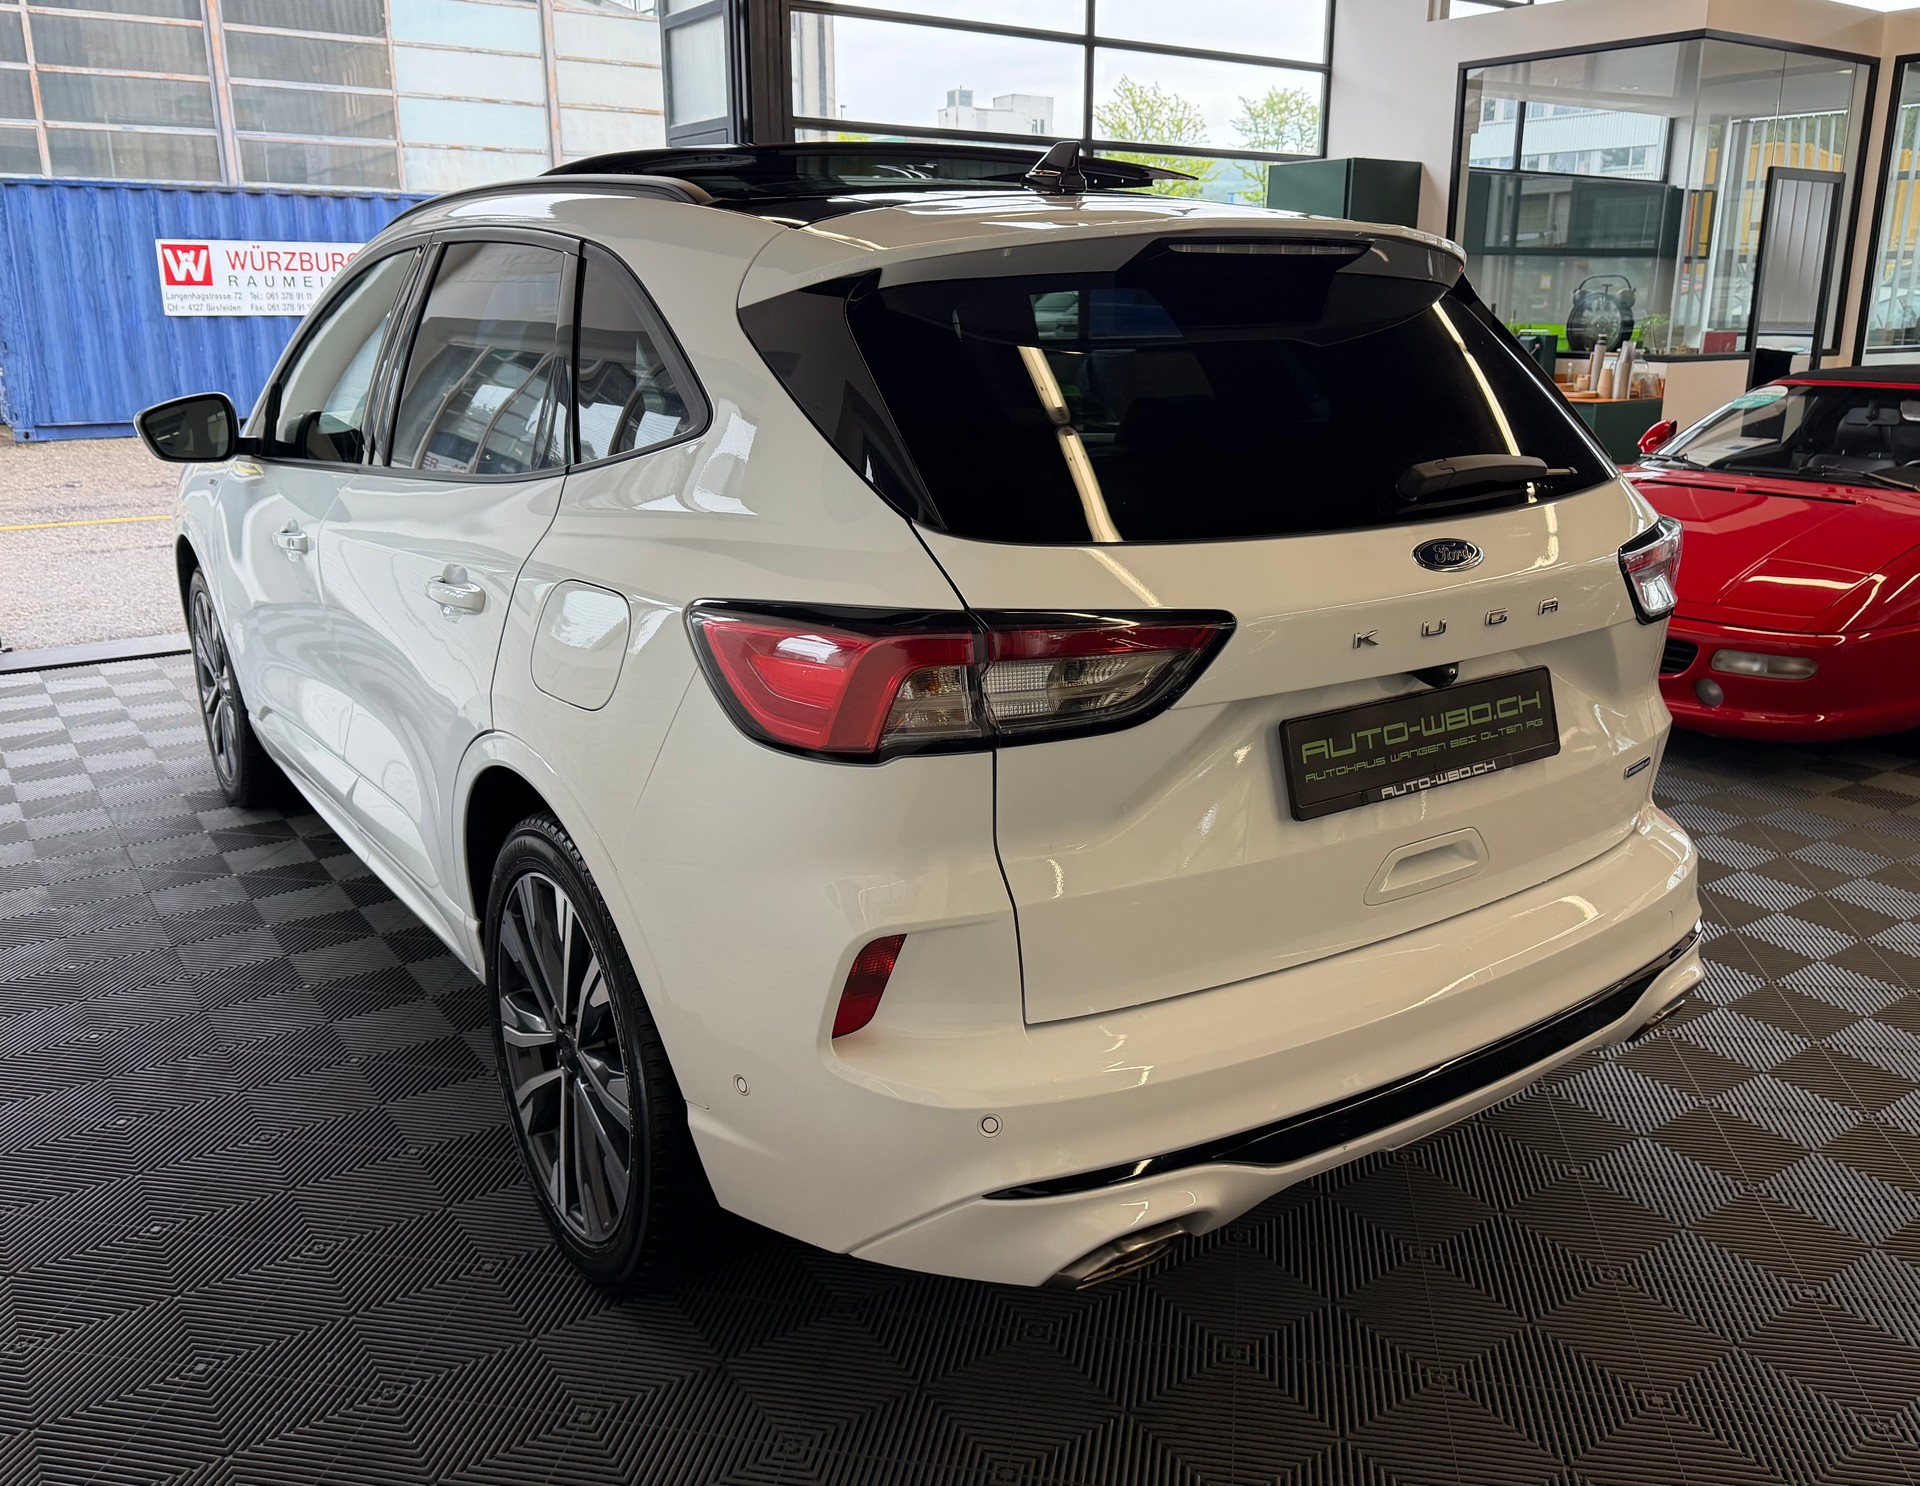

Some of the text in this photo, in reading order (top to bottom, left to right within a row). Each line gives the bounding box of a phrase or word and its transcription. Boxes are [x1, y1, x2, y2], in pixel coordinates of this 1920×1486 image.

[165, 291, 232, 301] Langenhagstrasse
[234, 291, 242, 300] 72
[265, 292, 279, 300] 061
[296, 292, 304, 300] 91
[306, 292, 312, 300] 11
[228, 275, 335, 288] RAUMEI
[167, 303, 179, 312] CH
[206, 302, 242, 311] Birsfelden
[267, 303, 280, 311] 061
[1433, 542, 1472, 563] Ford
[1352, 596, 1559, 649] KUGA
[1301, 690, 1542, 765] AUTO-WBO.CH
[1305, 717, 1544, 783] AUTOHAUS WANGEN BEI OLTEN AG
[1381, 760, 1497, 799] AUTO-WBO.CH
